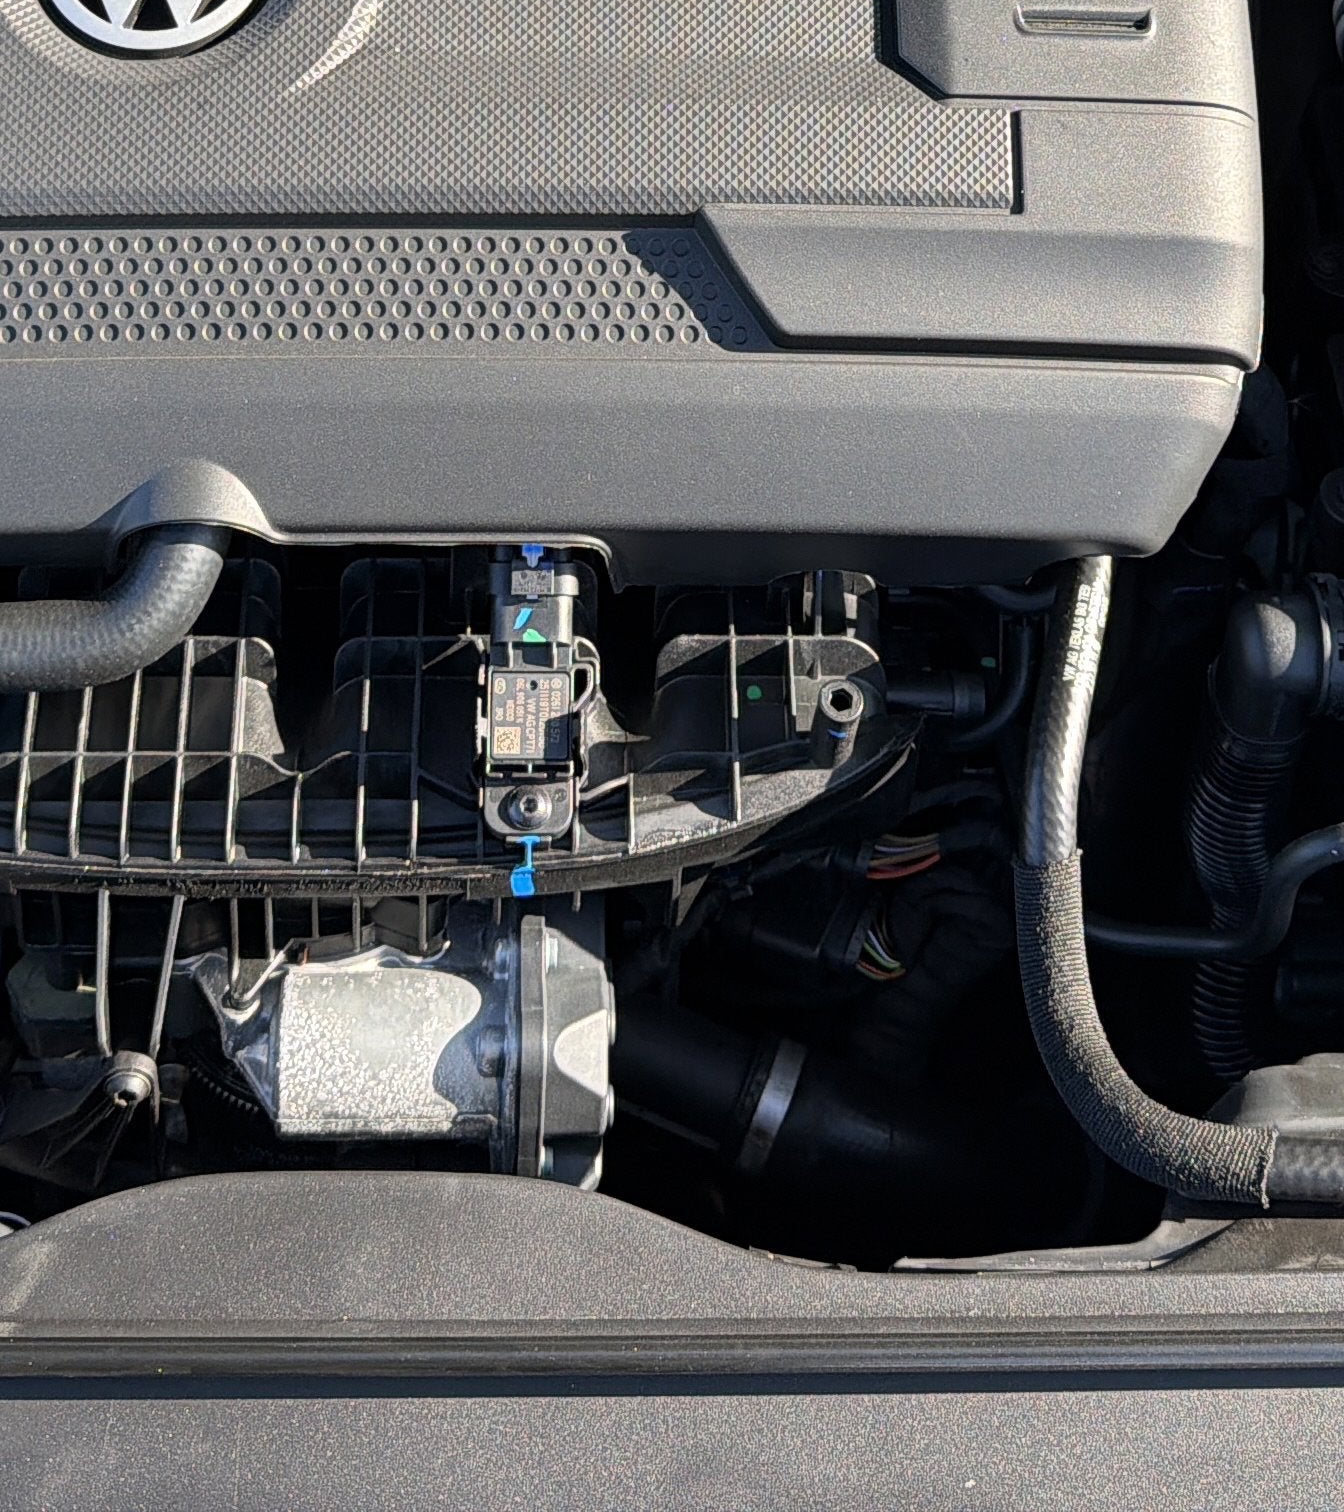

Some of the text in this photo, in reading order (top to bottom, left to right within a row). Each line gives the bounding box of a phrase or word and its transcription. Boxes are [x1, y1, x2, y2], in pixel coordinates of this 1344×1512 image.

[1065, 650, 1078, 665] AG
[1062, 663, 1076, 680] VW
[526, 698, 535, 713] VW
[525, 714, 535, 727] AG
